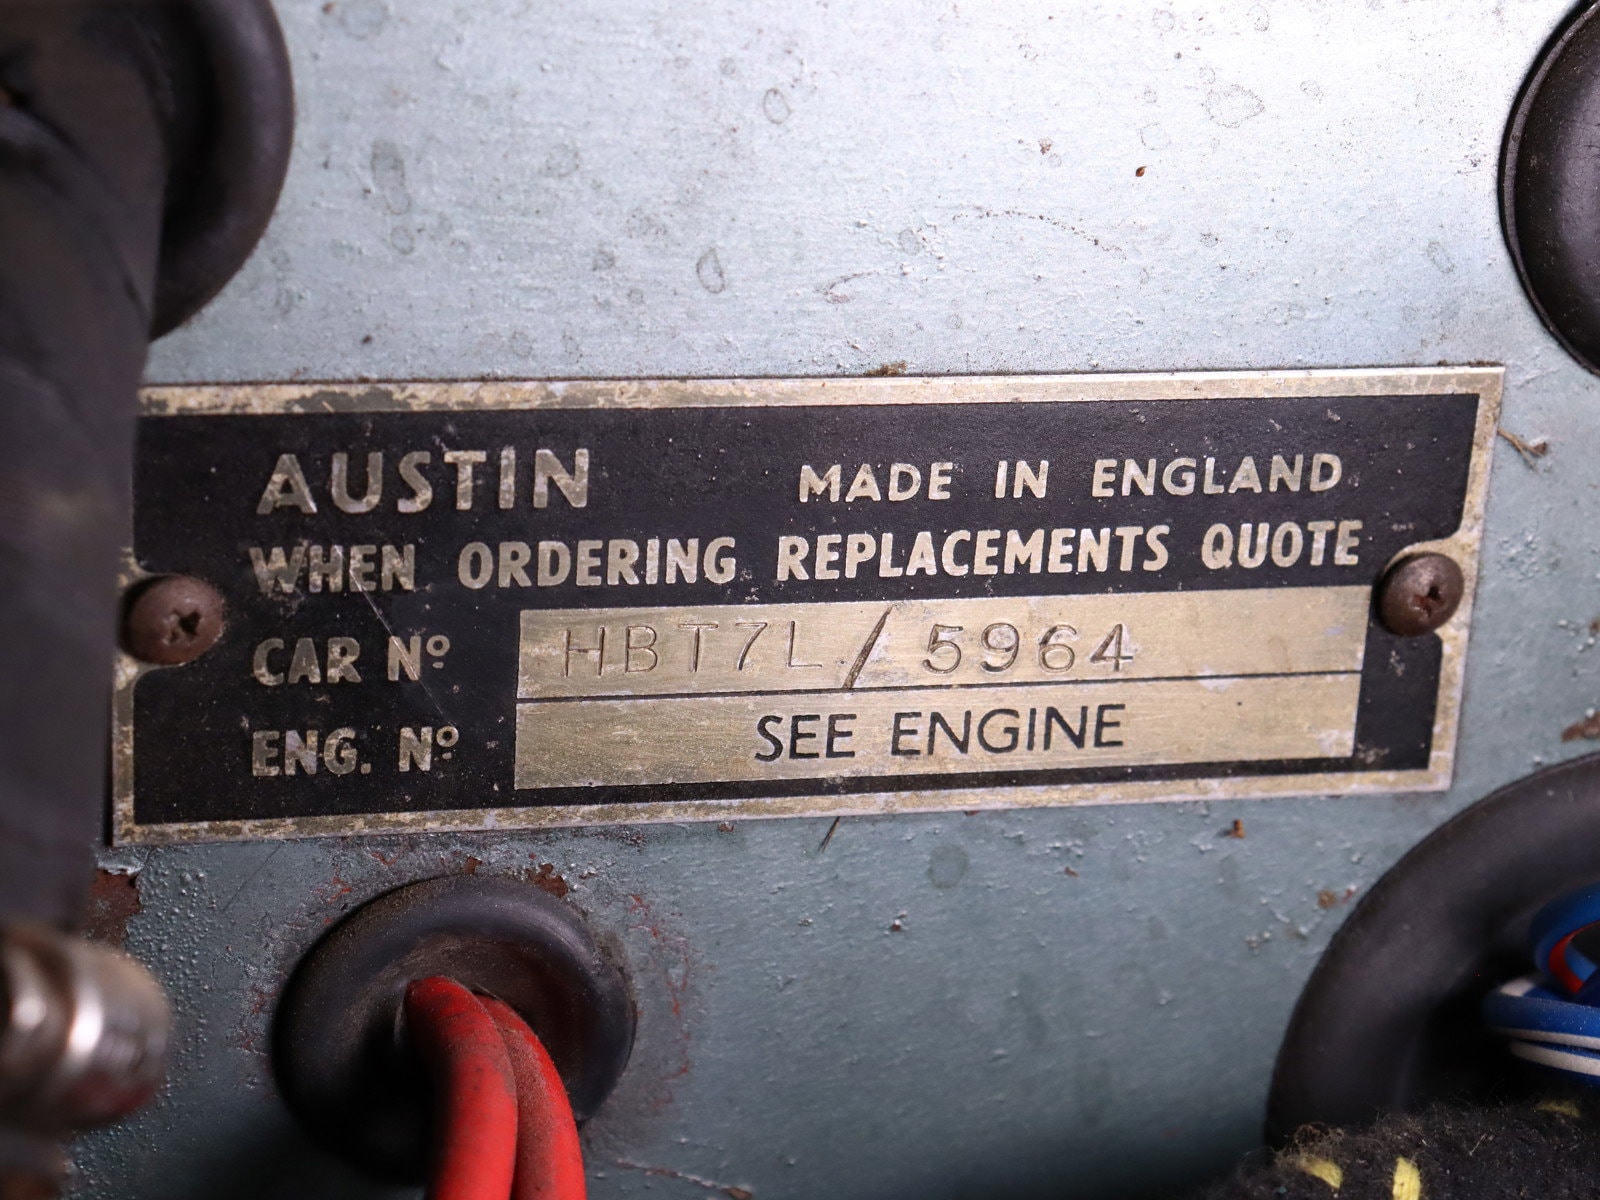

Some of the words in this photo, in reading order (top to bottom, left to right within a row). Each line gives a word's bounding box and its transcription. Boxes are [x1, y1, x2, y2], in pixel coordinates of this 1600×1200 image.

[256, 447, 590, 514] AUSTIN
[799, 461, 954, 503] MADE
[995, 460, 1050, 498] IN
[1092, 453, 1343, 498] ENGLAND
[249, 543, 416, 594] WHEN
[457, 536, 737, 589] ORDERING
[777, 524, 1171, 581] REPLACEMENTS
[1201, 520, 1364, 570] QUOTE
[252, 636, 362, 687] CAR
[251, 729, 372, 777] ENG.
[755, 713, 857, 762] SEE
[891, 703, 1127, 757] ENGINE
